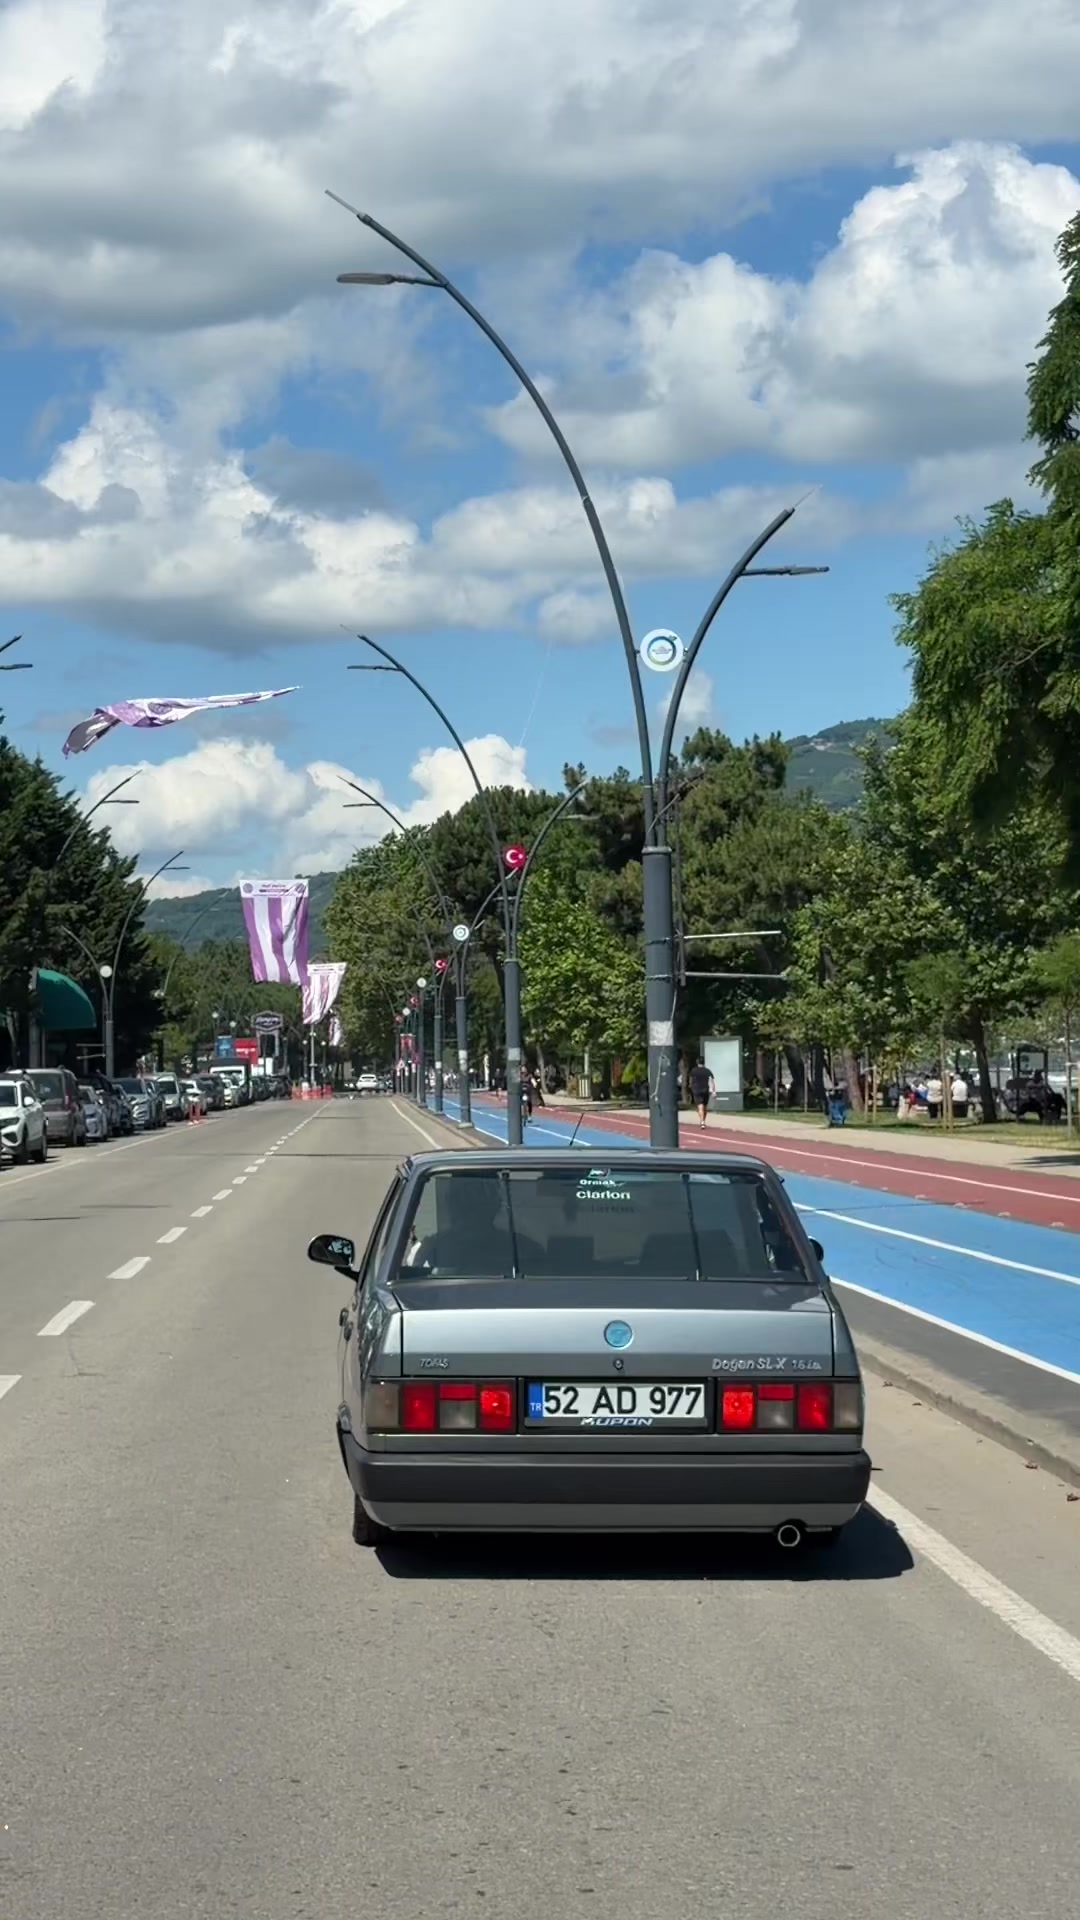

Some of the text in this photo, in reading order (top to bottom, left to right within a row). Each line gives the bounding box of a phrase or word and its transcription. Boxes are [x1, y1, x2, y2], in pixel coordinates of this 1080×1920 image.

[530, 1385, 702, 1415] TR 52 AD 977
